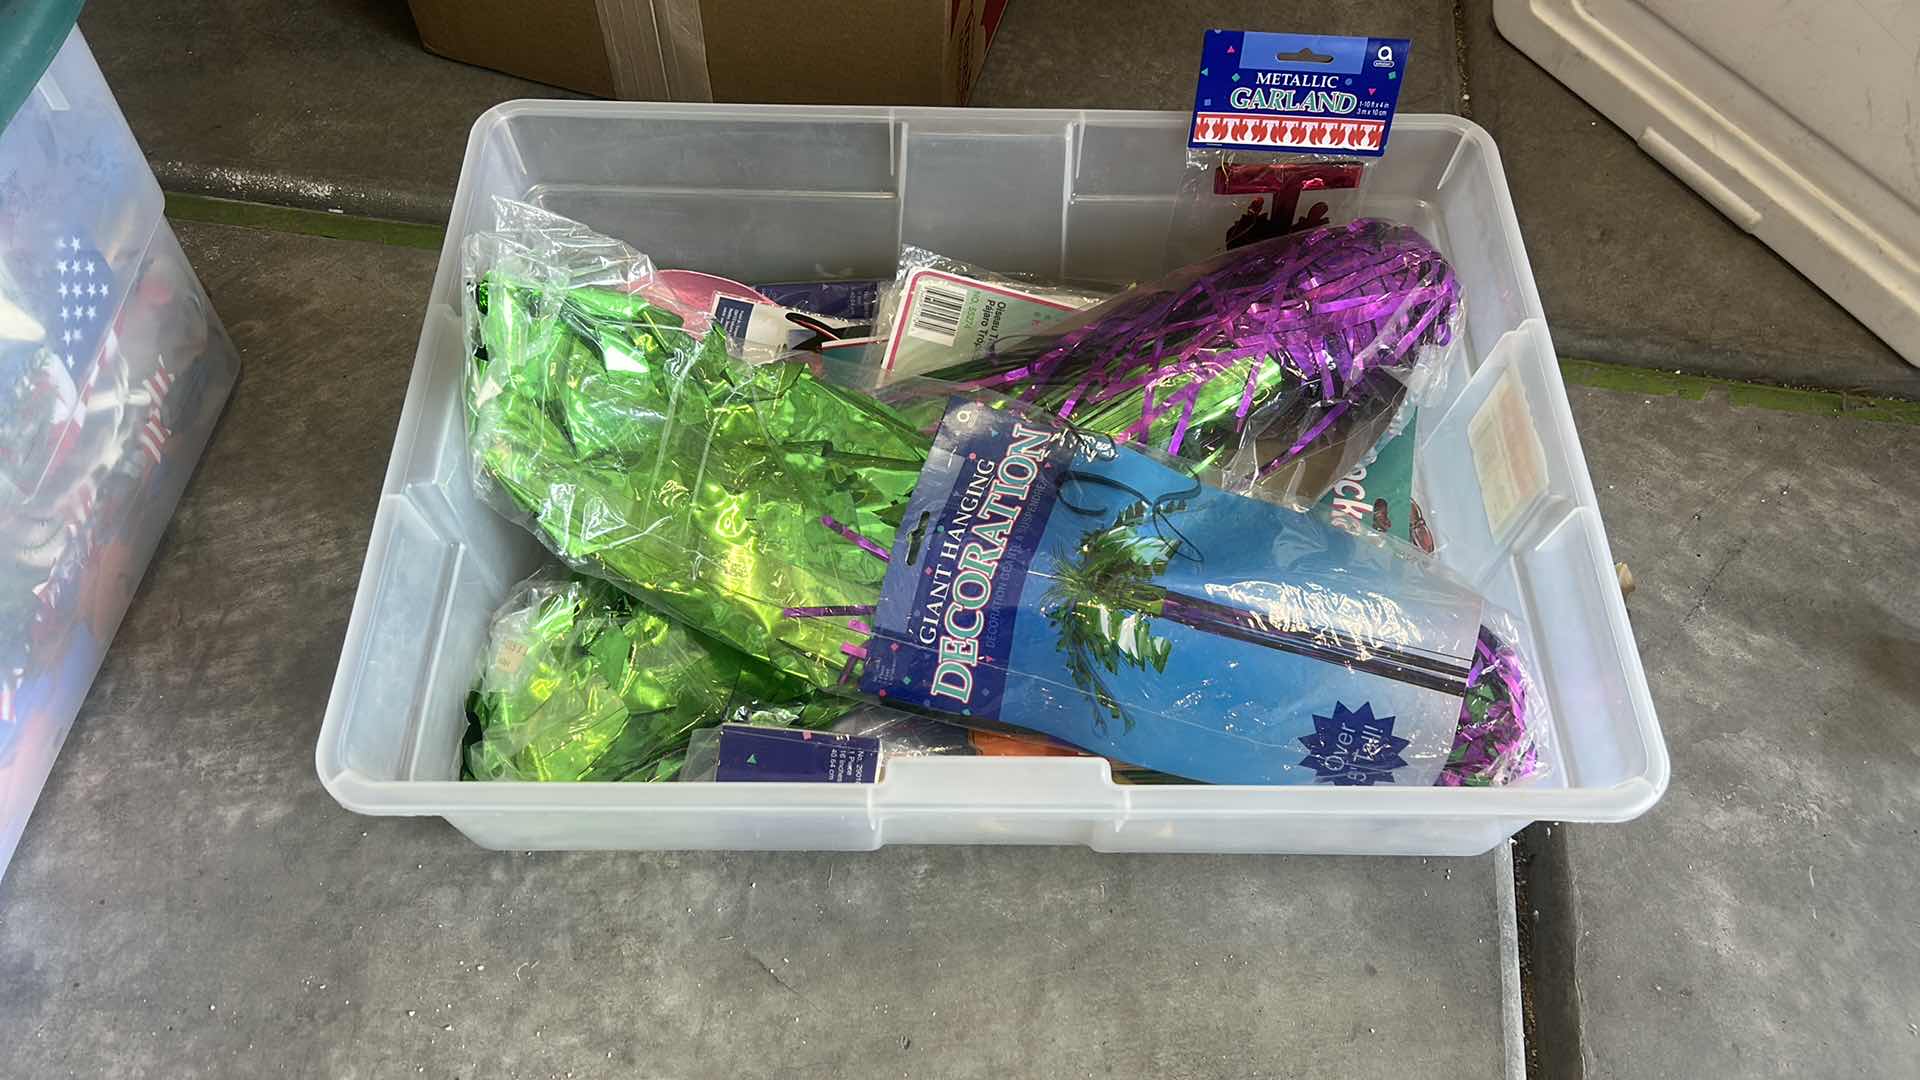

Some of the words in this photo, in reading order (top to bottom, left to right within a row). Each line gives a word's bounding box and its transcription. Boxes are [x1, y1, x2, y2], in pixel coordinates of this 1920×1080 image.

[1230, 87, 1358, 115] GARLAND
[1256, 71, 1339, 89] METALLIC
[919, 563, 953, 645] GIANT
[940, 458, 996, 561] HANGING
[930, 423, 1052, 704] DECORATION
[1324, 721, 1356, 771] Over
